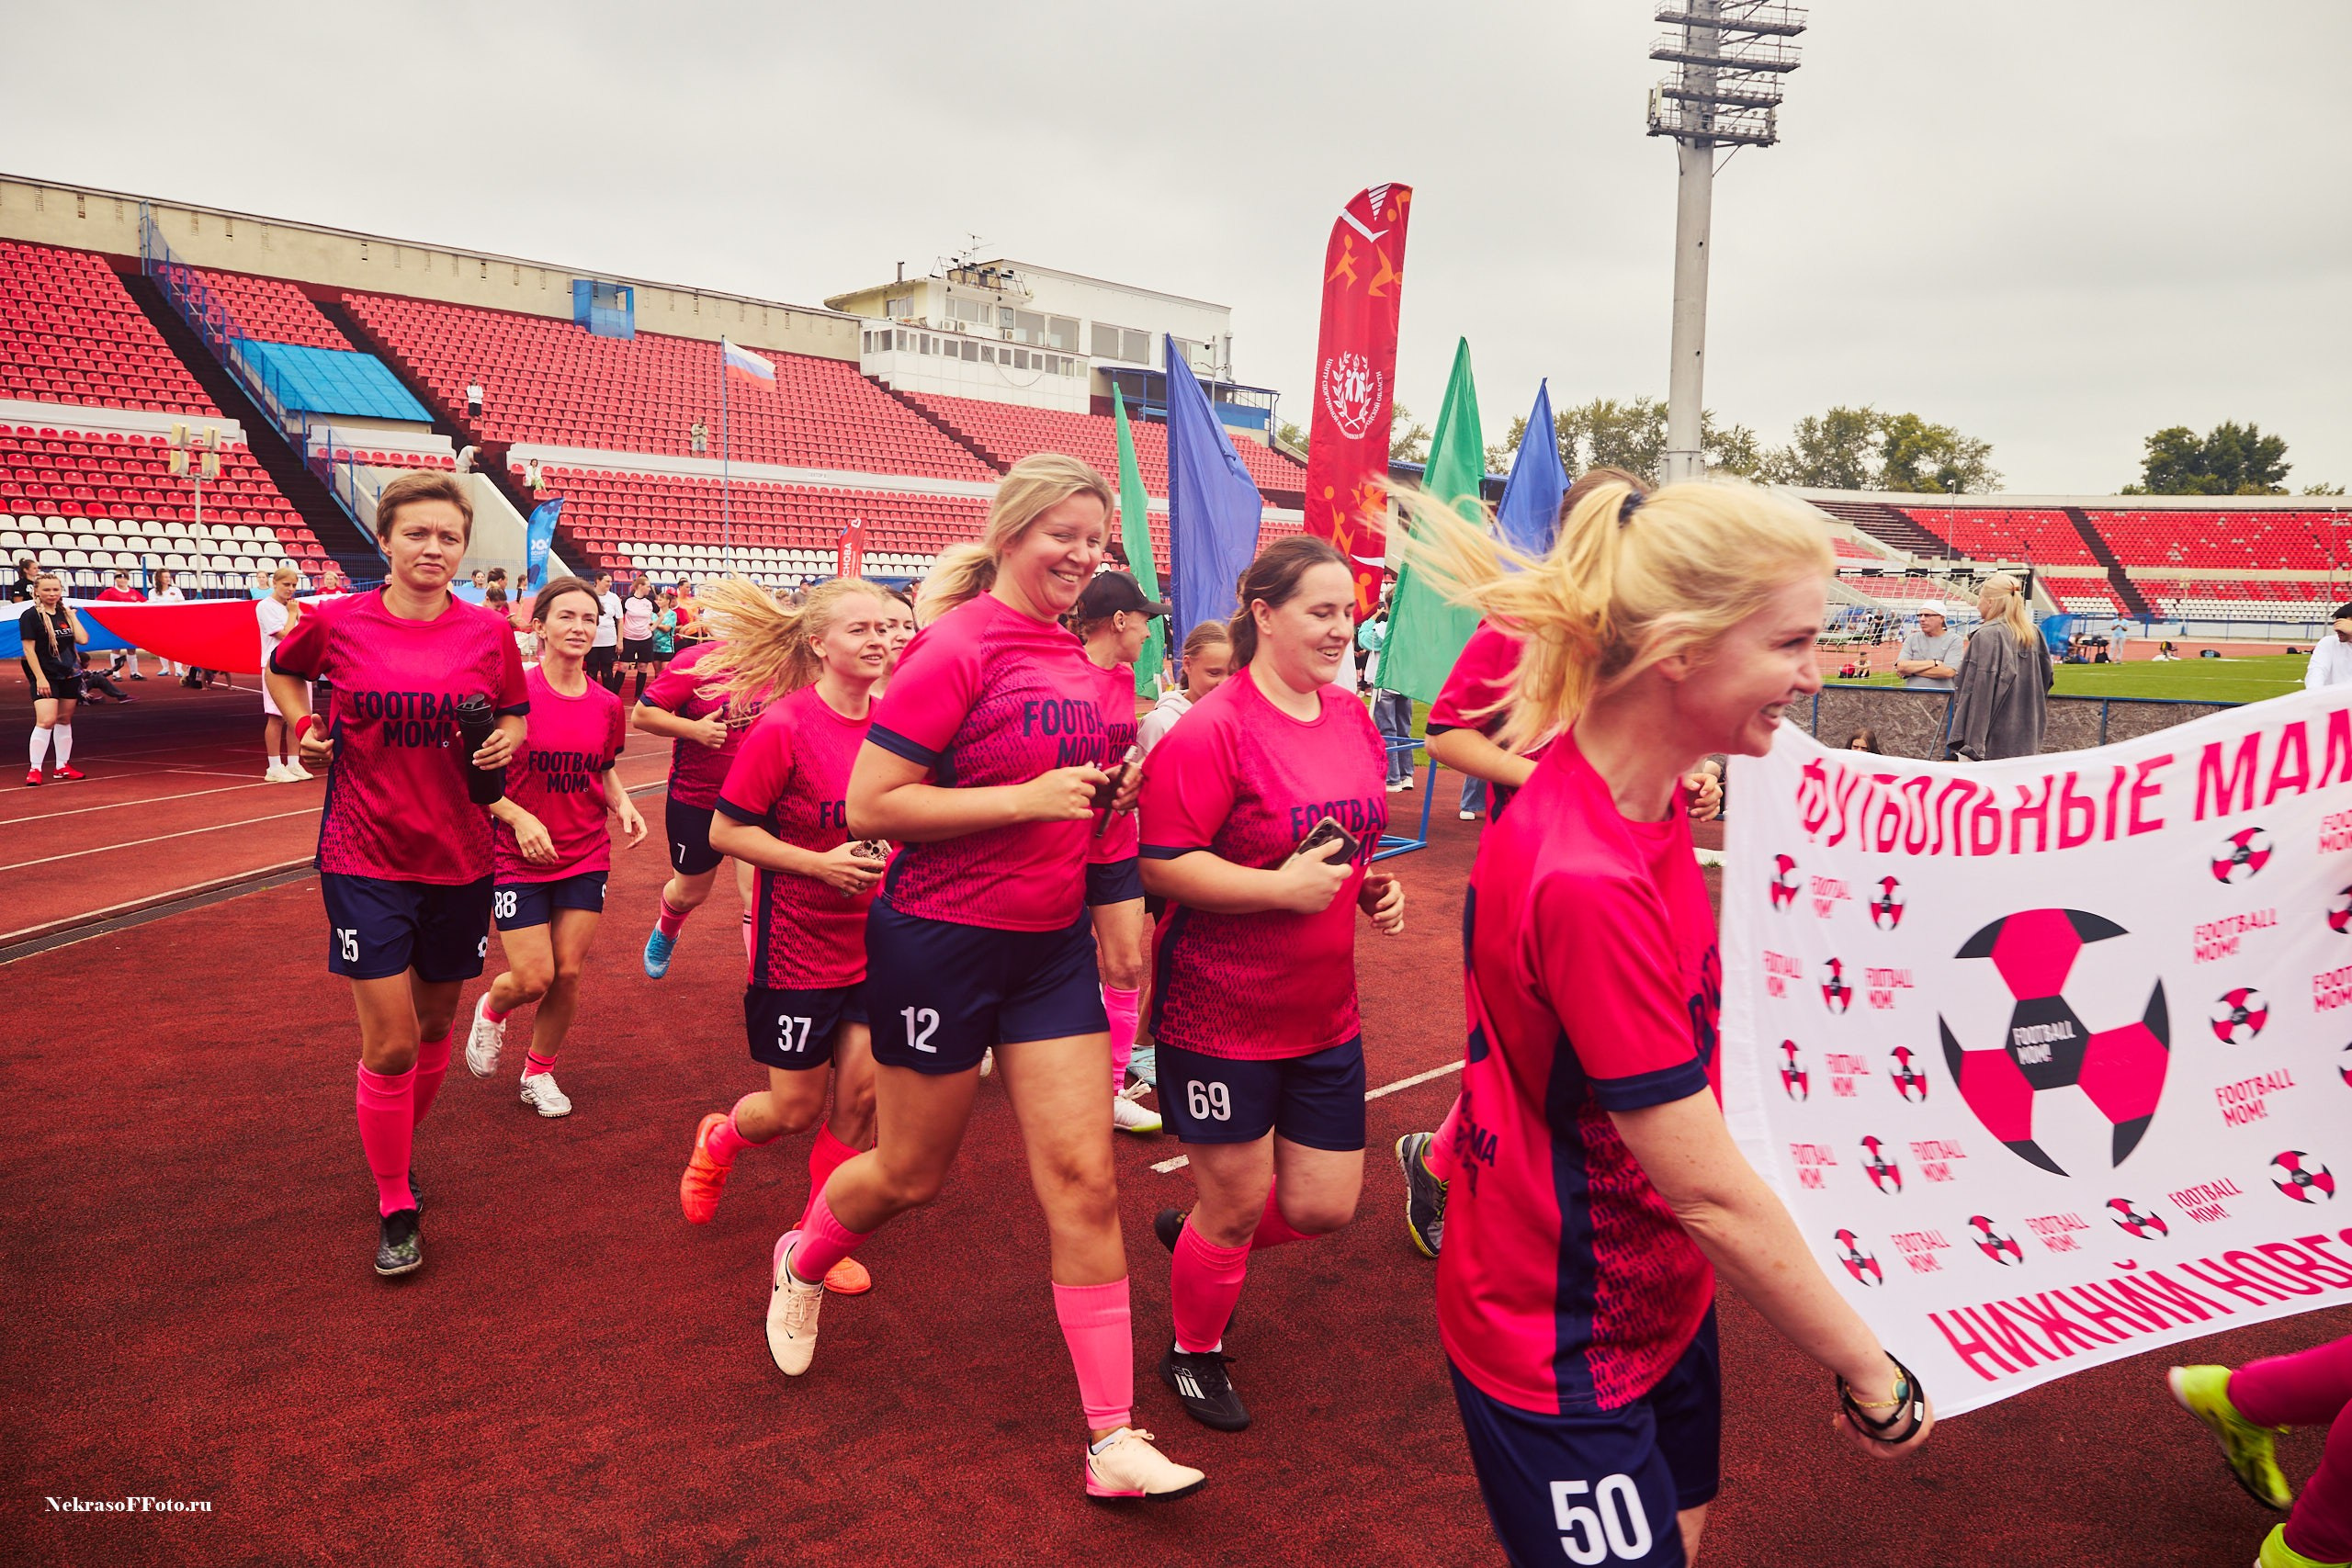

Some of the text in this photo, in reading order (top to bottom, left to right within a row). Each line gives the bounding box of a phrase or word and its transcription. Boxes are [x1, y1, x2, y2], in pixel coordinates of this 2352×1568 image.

[842, 542, 853, 577] СНОВА
[383, 720, 452, 749] MOM!
[547, 773, 590, 794] MOM!
[677, 842, 687, 864] 7
[494, 891, 517, 919] 88
[2194, 908, 2278, 943] FOOTBALL
[2193, 936, 2240, 964] MOM!
[777, 1014, 812, 1053] 37
[899, 1005, 941, 1054] 12
[1187, 1079, 1231, 1122] 69
[2215, 1068, 2297, 1107] FOOTBALL
[2222, 1099, 2268, 1128] MOM!
[2167, 1177, 2244, 1210] FOOTBALL
[2024, 1213, 2091, 1236] FOOTBALL
[2185, 1203, 2233, 1225] MOM!
[1928, 1258, 2236, 1382] НИЖНИЙ
[1550, 1473, 1653, 1566] 50
